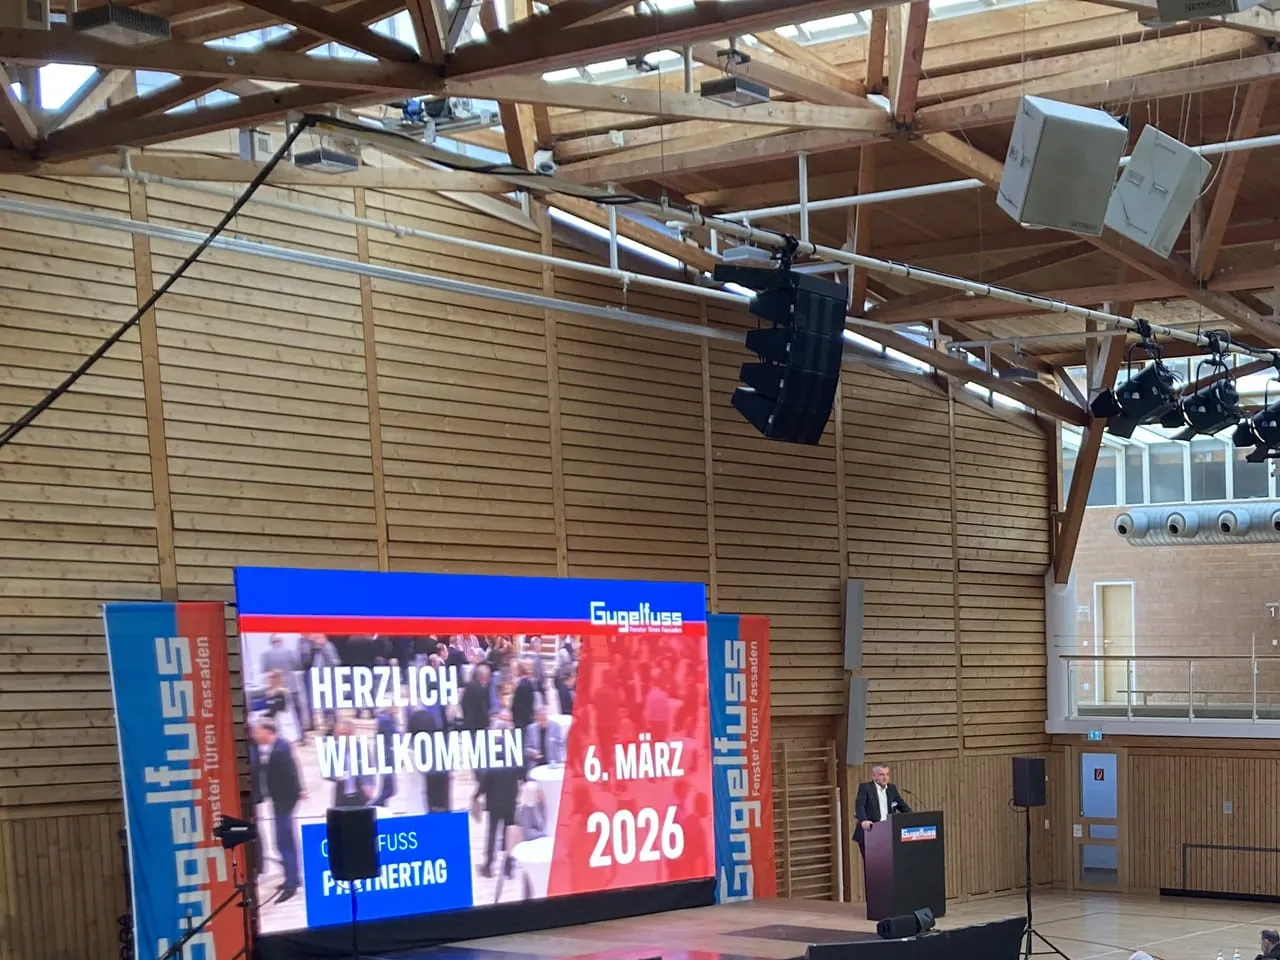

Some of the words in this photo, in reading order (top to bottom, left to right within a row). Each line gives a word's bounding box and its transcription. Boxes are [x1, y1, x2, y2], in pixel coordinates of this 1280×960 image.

[590, 601, 683, 632] Gugelfuss
[1269, 606, 1275, 617] 1
[195, 636, 214, 718] Fassaden
[311, 665, 459, 709] HERZLICH
[748, 641, 758, 703] Fassaden
[203, 724, 219, 772] Türen
[749, 707, 759, 744] Türen
[315, 728, 523, 778] WILLKOMMEN
[584, 744, 609, 782] 6.
[615, 732, 685, 781] MÄRZ
[713, 640, 761, 904] Gugelfuss
[752, 748, 761, 796] Fenster
[586, 805, 685, 868] 2026
